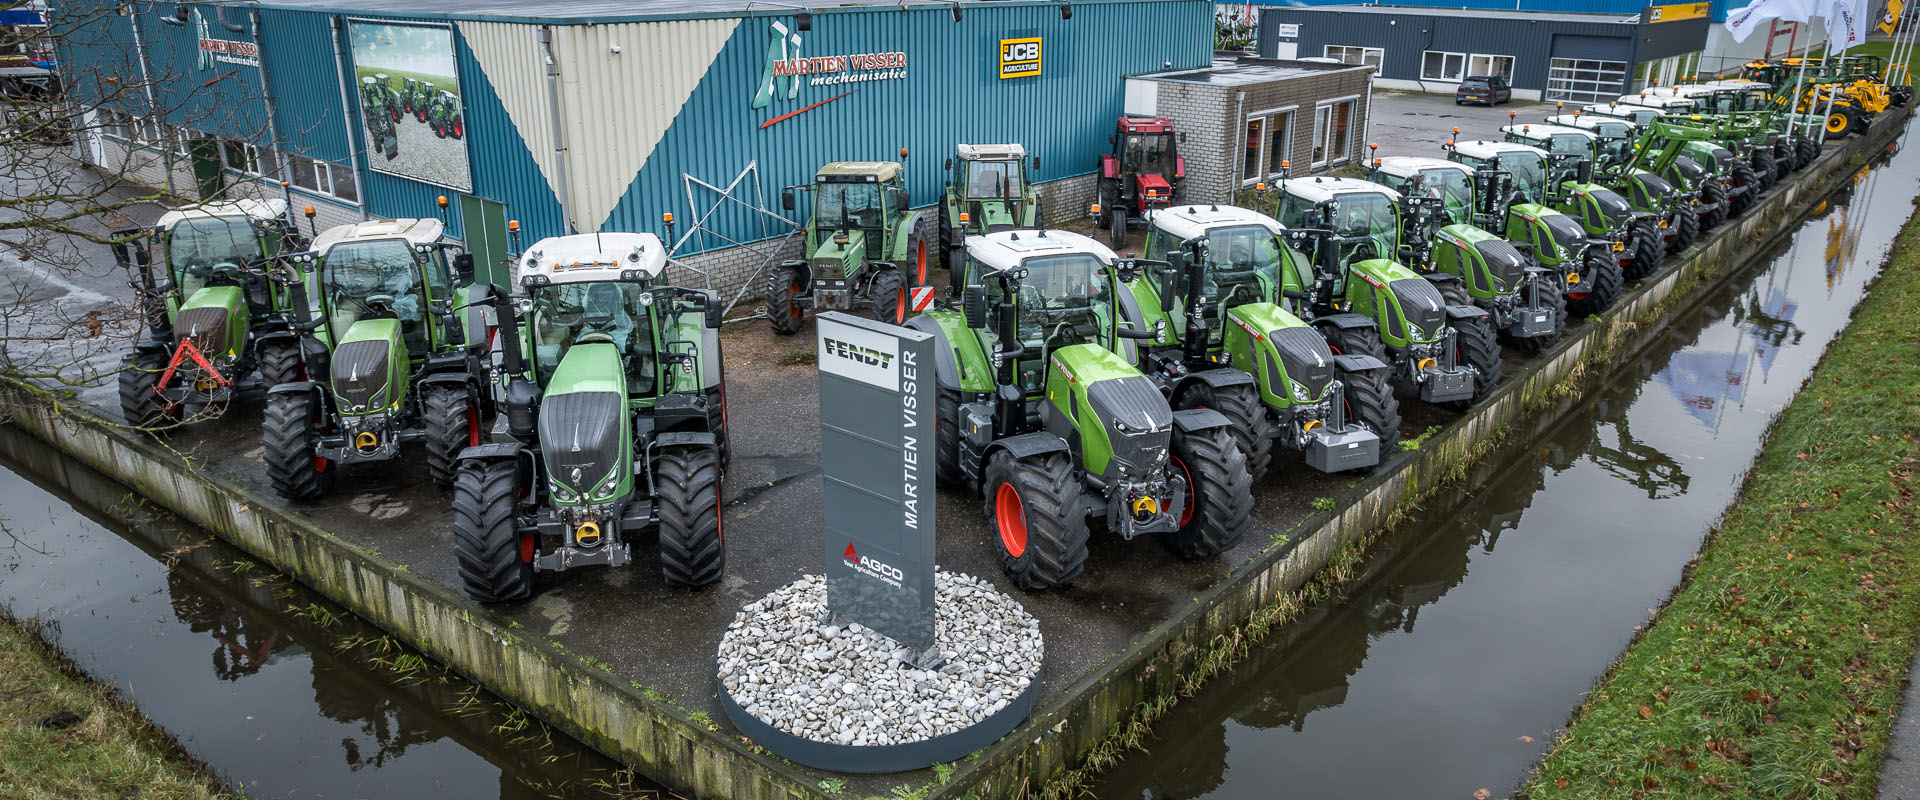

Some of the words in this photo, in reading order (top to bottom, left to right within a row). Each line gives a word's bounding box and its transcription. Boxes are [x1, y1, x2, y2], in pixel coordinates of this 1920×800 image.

[199, 38, 228, 53] MARTIEN
[1003, 43, 1039, 62] JCB
[216, 54, 260, 67] mechanisatie
[772, 55, 847, 77] MARTIEN
[849, 52, 906, 71] VISSER
[1003, 63, 1039, 73] AGRICULTURE
[810, 69, 907, 86] mechanisatie
[1244, 322, 1260, 338] FENDT
[823, 336, 895, 370] FENDT
[903, 350, 917, 428] VISSER
[903, 435, 918, 530] MARTIEN
[843, 559, 854, 569] Your
[854, 564, 879, 579] Agriculture
[879, 574, 902, 590] Company
[860, 555, 903, 581] AGCO
